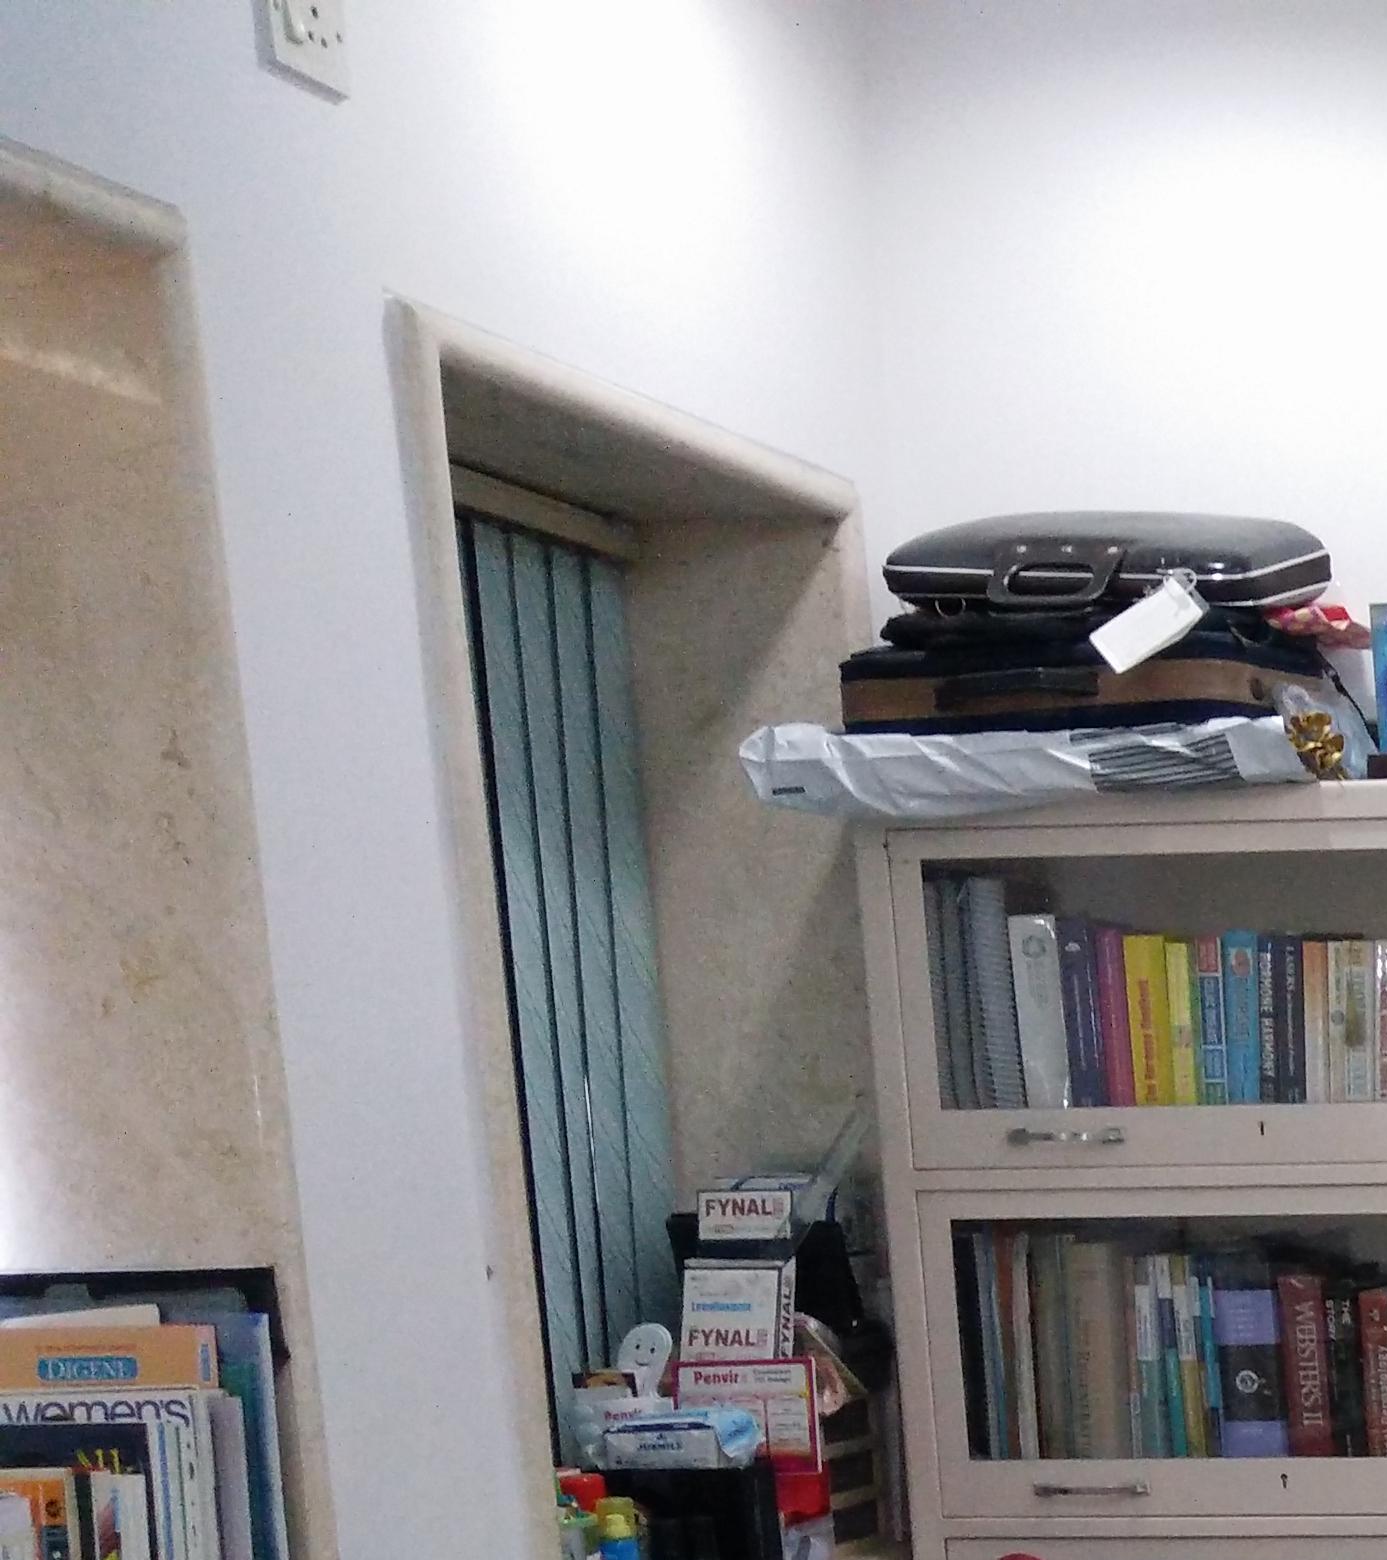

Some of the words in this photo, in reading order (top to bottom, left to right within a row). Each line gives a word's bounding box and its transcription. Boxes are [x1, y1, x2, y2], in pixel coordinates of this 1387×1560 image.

[704, 1198, 773, 1218] FYNAL
[780, 1285, 794, 1358] FYNAL
[688, 1328, 757, 1348] FYNAL
[693, 1370, 740, 1386] Penvir
